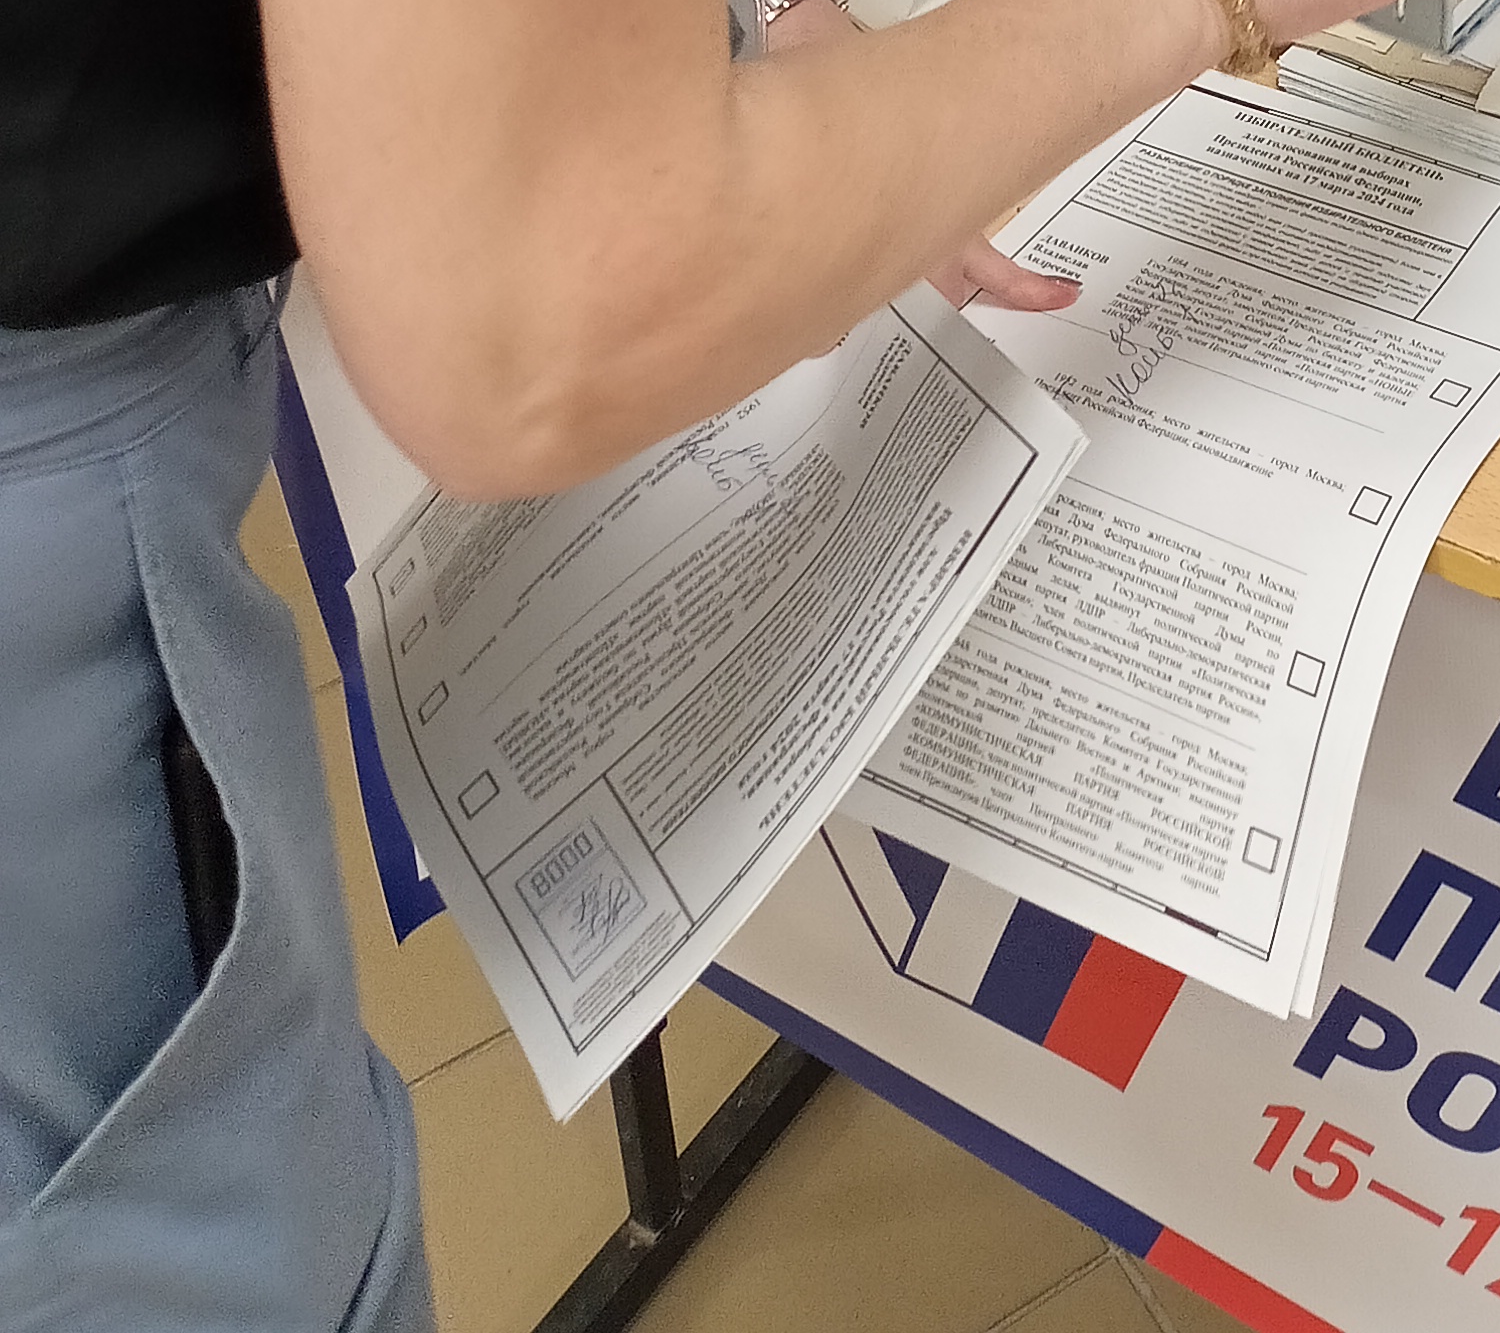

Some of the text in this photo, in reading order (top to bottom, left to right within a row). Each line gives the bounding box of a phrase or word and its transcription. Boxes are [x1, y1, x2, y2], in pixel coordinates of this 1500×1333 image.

[1206, 146, 1415, 216] назначенных на 17 марта 2024 года
[1213, 134, 1423, 207] Президента Российской Федерации,
[1235, 112, 1444, 181] ИЗБИРАТЕЛЬНЫЙ БЮЛЛЕТЕНЬ
[1242, 133, 1410, 188] для голосования на выборах
[1027, 253, 1081, 279] Андреевич
[1033, 243, 1089, 269] Владислав
[1041, 235, 1110, 264] ДАВАНКОВ
[1081, 396, 1274, 478] Российской Федерации; самовыдвижение
[1081, 384, 1103, 397] года
[1106, 395, 1156, 419] рождения;
[1163, 415, 1191, 431] место
[1197, 430, 1251, 454] жительства
[1270, 457, 1300, 474] город
[1305, 468, 1344, 492] Москва;
[1055, 493, 1104, 521] рождения;
[1038, 534, 1283, 646] Либерально-демократической партии России,
[1067, 513, 1294, 615] Дума Федерального Собрания Российской
[1071, 533, 1289, 630] руководитель фракции Политической партии
[1047, 553, 1280, 660] Комитета Государственной Думы по
[1050, 574, 1275, 676] делам; выдвинут политической партией
